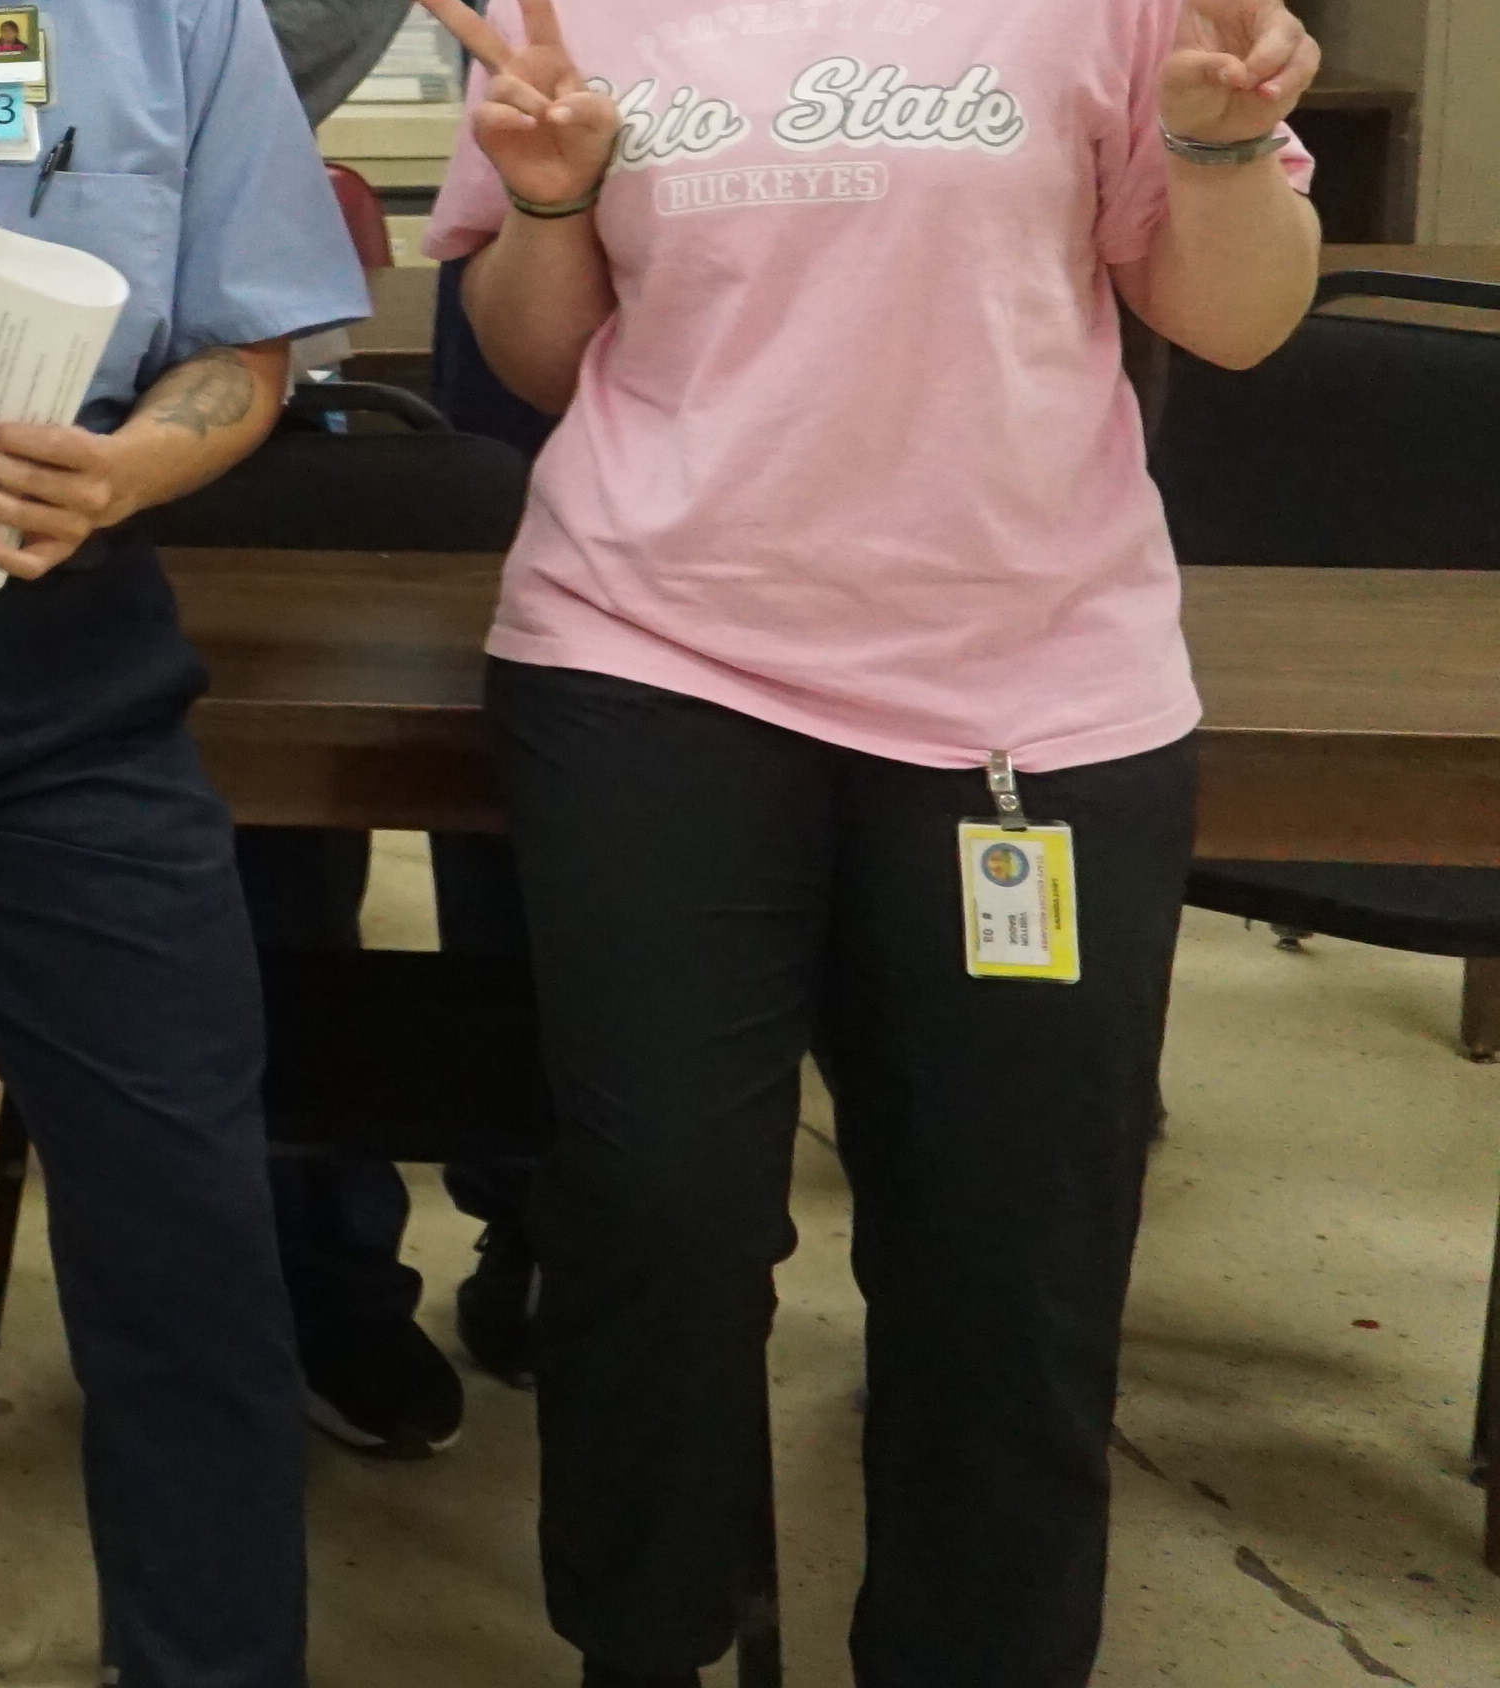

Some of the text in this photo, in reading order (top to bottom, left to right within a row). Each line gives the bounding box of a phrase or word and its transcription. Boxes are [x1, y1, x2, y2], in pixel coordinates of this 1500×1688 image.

[585, 55, 1030, 168] hio State
[669, 166, 881, 211] BUCKEYES
